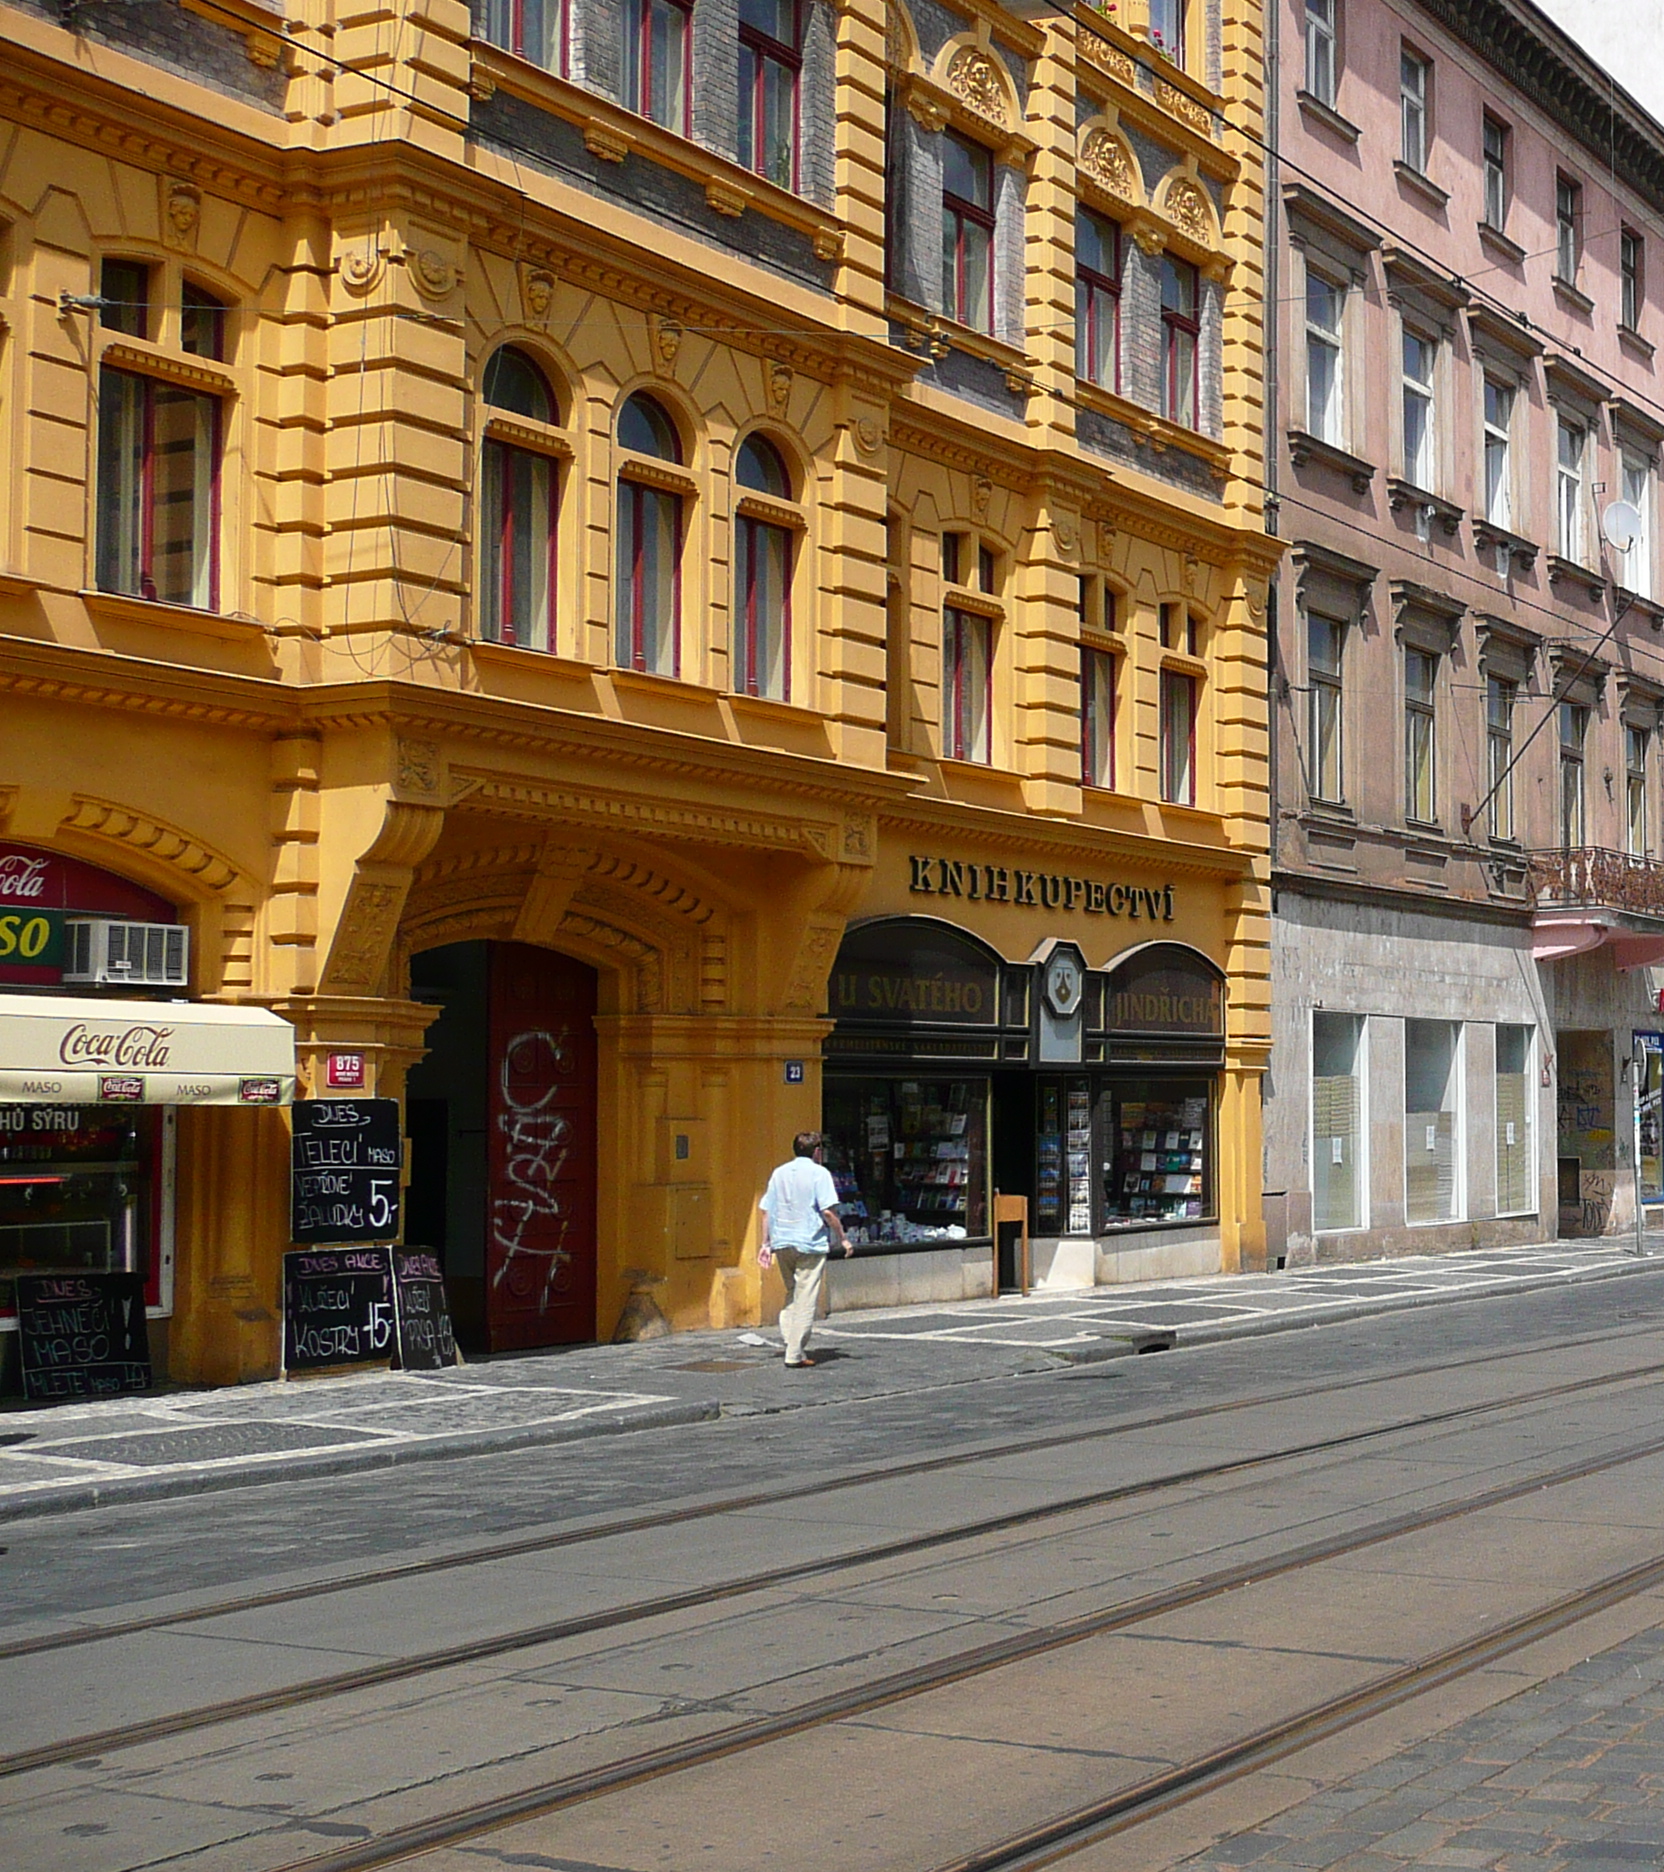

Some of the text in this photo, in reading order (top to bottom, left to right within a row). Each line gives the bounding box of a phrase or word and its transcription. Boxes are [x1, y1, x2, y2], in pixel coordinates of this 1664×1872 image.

[909, 855, 1176, 921] KNIHKUPECTVÍ
[838, 972, 982, 1014] U SVATÉHO
[1115, 986, 1217, 1027] JINDŘICHA
[59, 1023, 175, 1067] Coca-Cola
[336, 1056, 359, 1071] 875
[22, 1081, 62, 1094] MASO
[176, 1084, 212, 1096] MASO
[32, 1108, 79, 1132] SÝRU
[312, 1104, 360, 1124] DNES
[294, 1132, 395, 1165] TELECÍ MASO
[33, 1334, 110, 1366] MASO
[294, 1320, 360, 1359] KOSTRY
